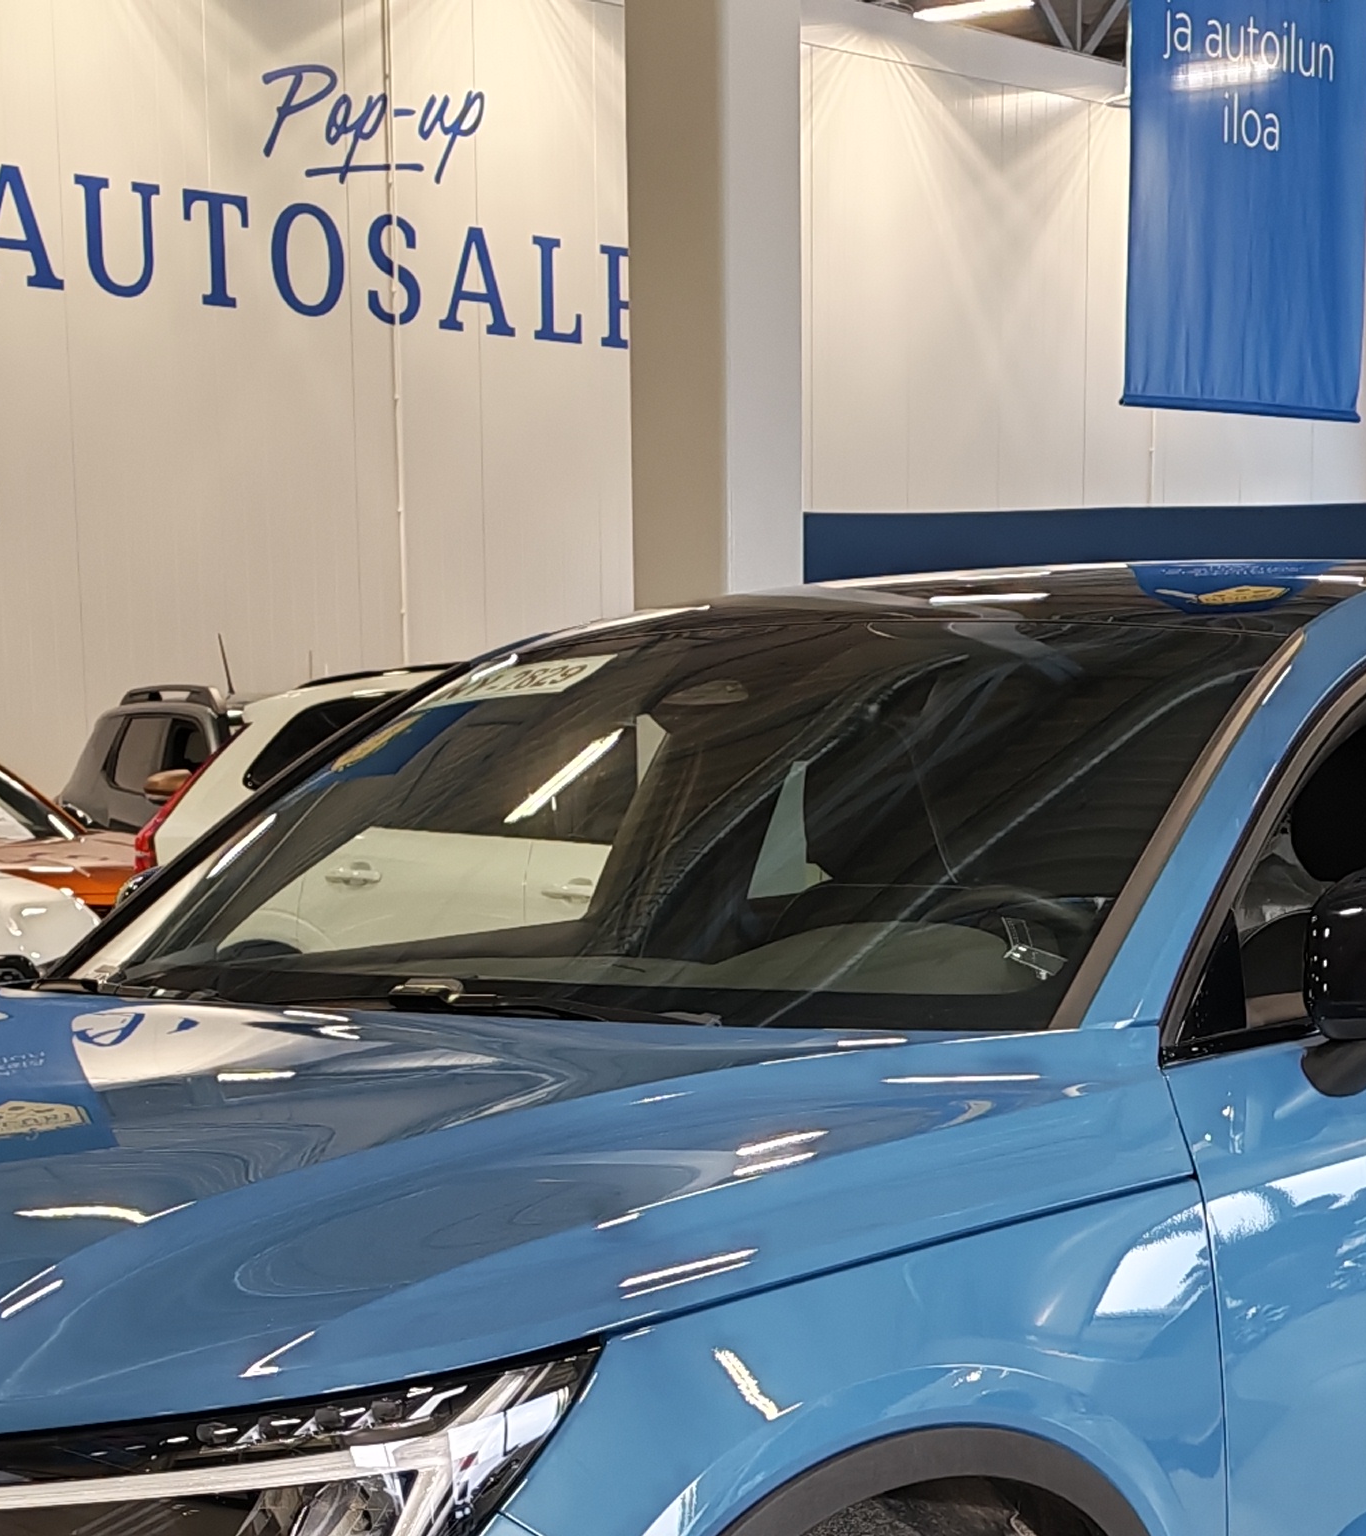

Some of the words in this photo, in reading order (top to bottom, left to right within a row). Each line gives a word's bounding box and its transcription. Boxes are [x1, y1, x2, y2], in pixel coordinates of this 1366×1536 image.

[1162, 0, 1192, 60] ja
[1205, 16, 1333, 83] autoilun
[262, 64, 485, 185] Pop-up
[1223, 91, 1280, 151] iloa
